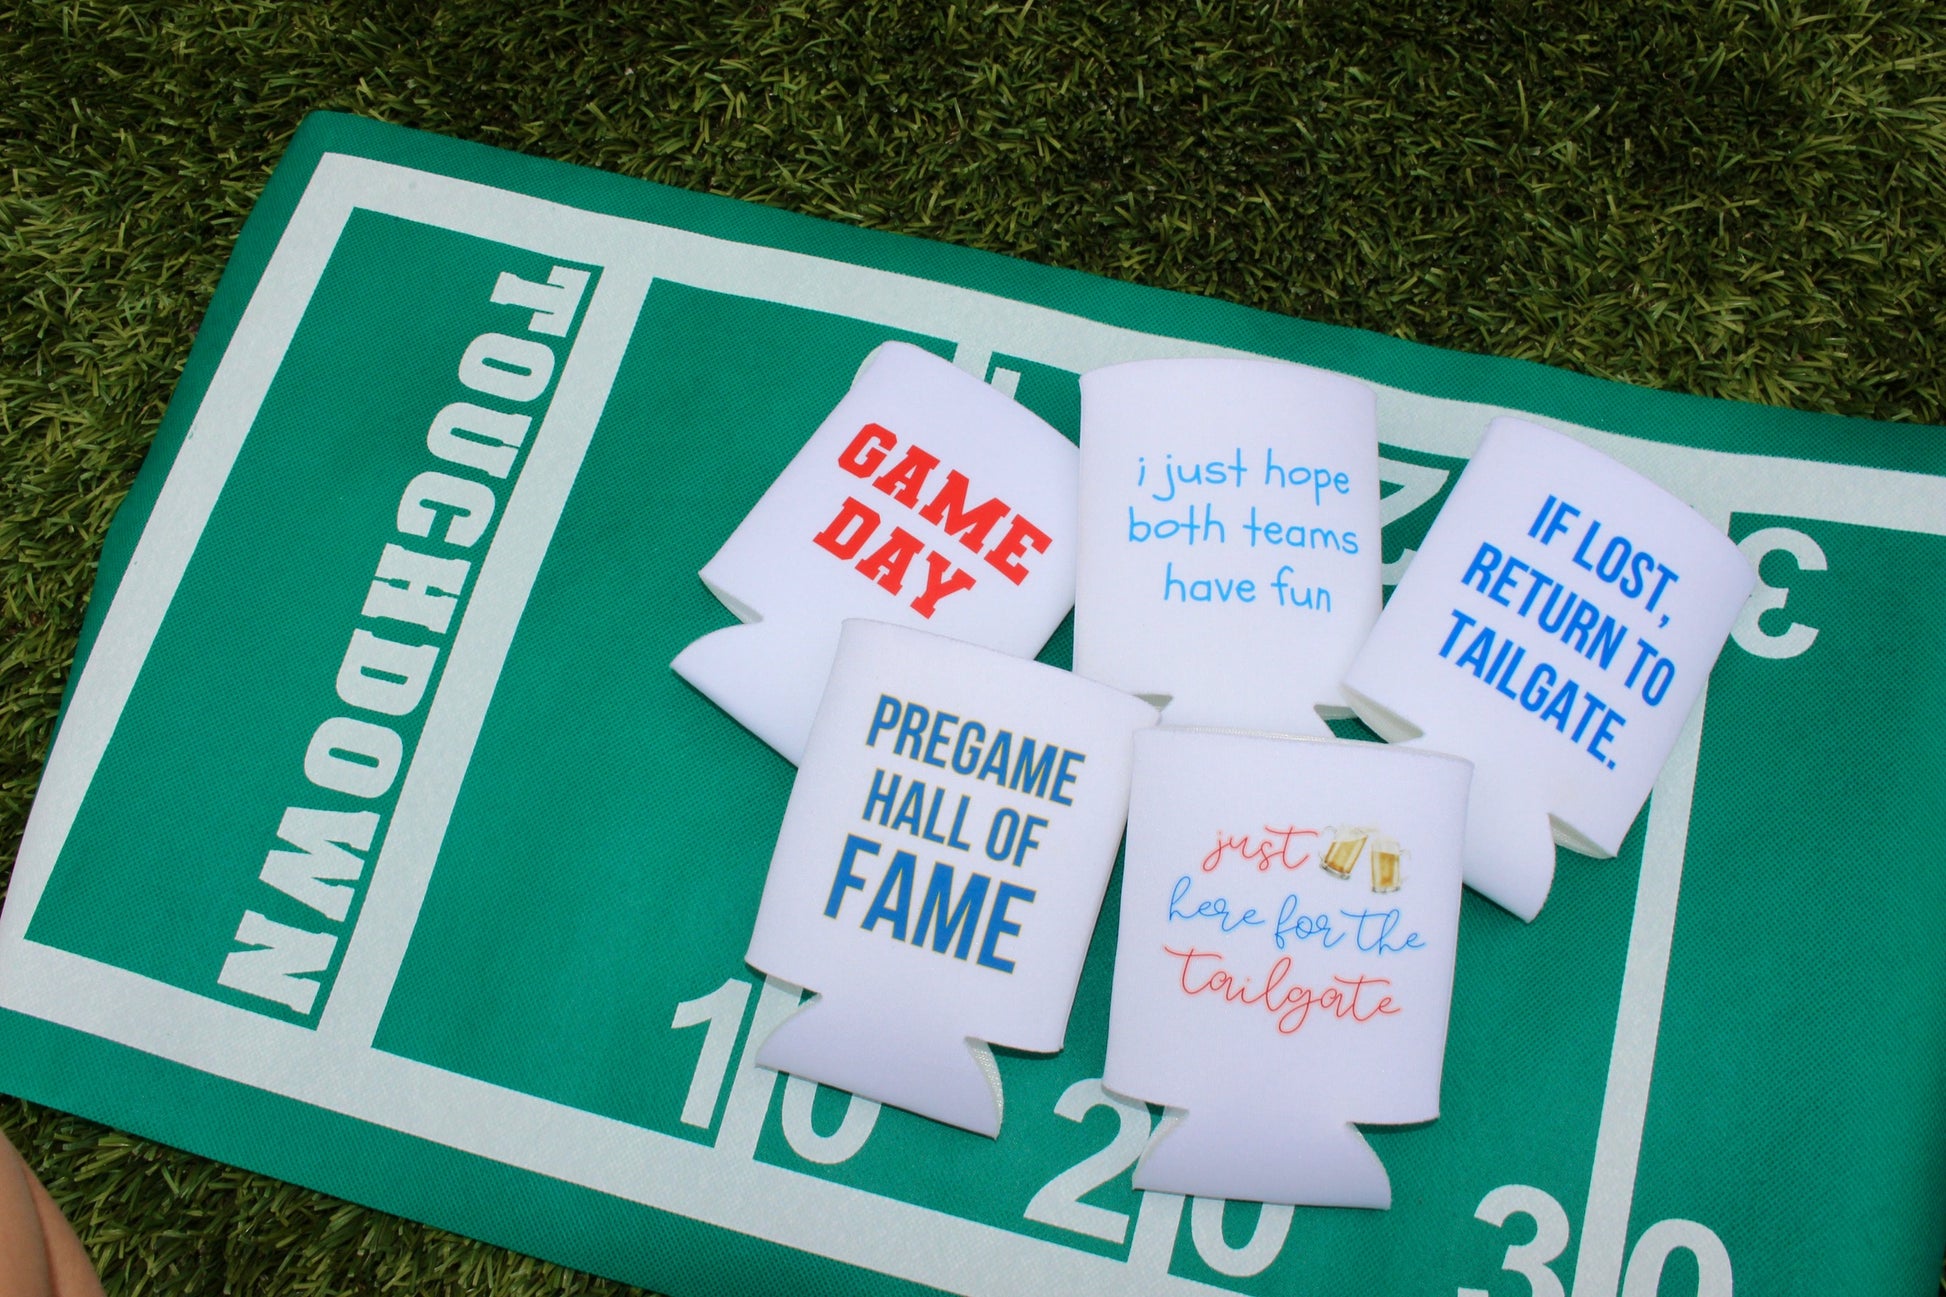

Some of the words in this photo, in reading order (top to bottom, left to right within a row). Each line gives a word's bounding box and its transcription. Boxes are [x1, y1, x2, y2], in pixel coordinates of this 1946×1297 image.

[837, 422, 1053, 585] GAME
[1127, 502, 1226, 546] both
[1241, 506, 1360, 555] teams
[1137, 456, 1147, 488] i
[1151, 447, 1248, 501] just
[1263, 447, 1350, 505] hope
[812, 496, 977, 619] DAY
[1163, 562, 1257, 603] have
[1269, 565, 1332, 613] fun
[1527, 493, 1582, 547] IF
[1572, 519, 1681, 629] LOST,
[217, 265, 590, 1015] TOUCHDOWN
[1460, 541, 1630, 672] RETURN
[1623, 637, 1678, 708] TO
[1438, 608, 1628, 771] TAILGATE.
[865, 694, 1087, 807] PREGAME
[861, 768, 972, 850] HALL
[984, 806, 1050, 867] OF
[1201, 825, 1319, 873] just
[823, 833, 1037, 974] FAME
[1167, 874, 1268, 933] here
[1272, 893, 1346, 951] for
[1338, 907, 1427, 956] the
[1163, 944, 1402, 1035] tailgate
